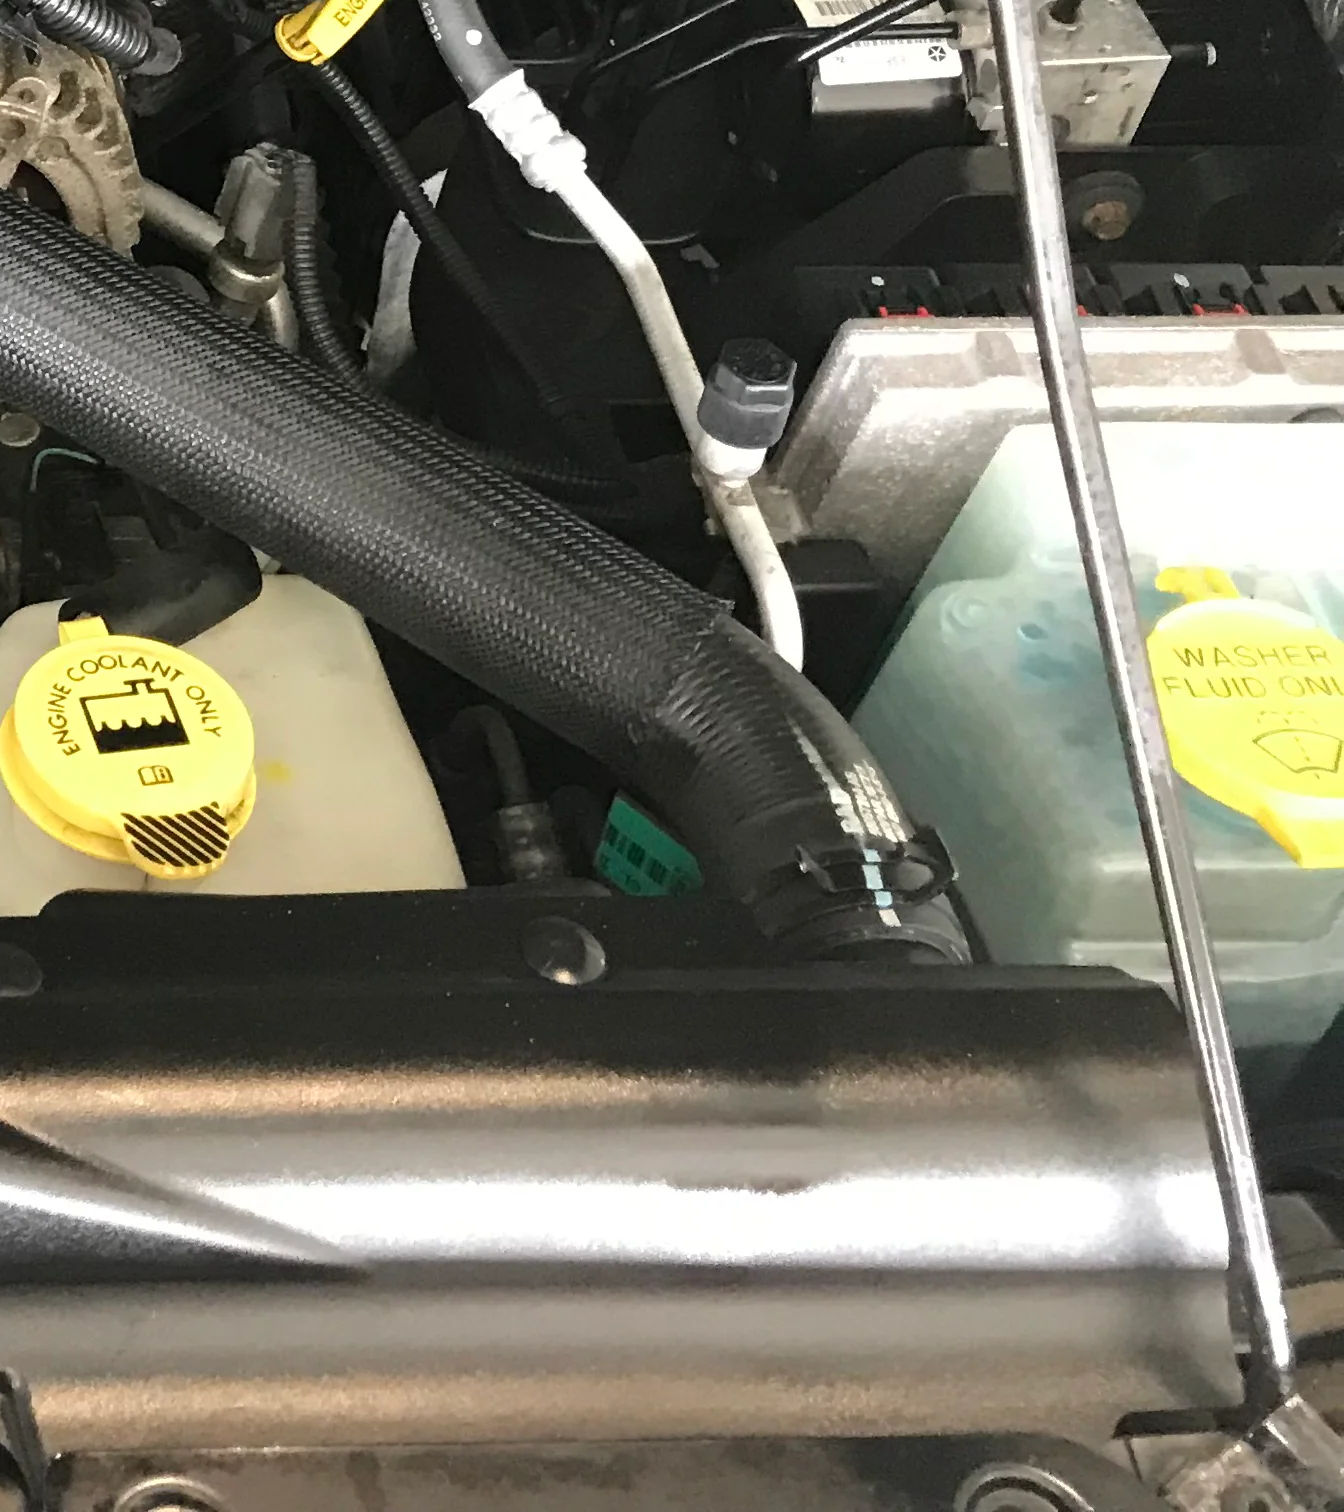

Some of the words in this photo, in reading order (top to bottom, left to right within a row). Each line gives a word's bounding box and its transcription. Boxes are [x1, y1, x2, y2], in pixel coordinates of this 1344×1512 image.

[1172, 645, 1333, 668] WASHER
[1161, 675, 1267, 699] FLUID
[1278, 675, 1344, 699] ONL
[47, 682, 82, 756] ENGINE
[66, 654, 185, 683] COOLANT
[185, 685, 223, 738] ONLY
